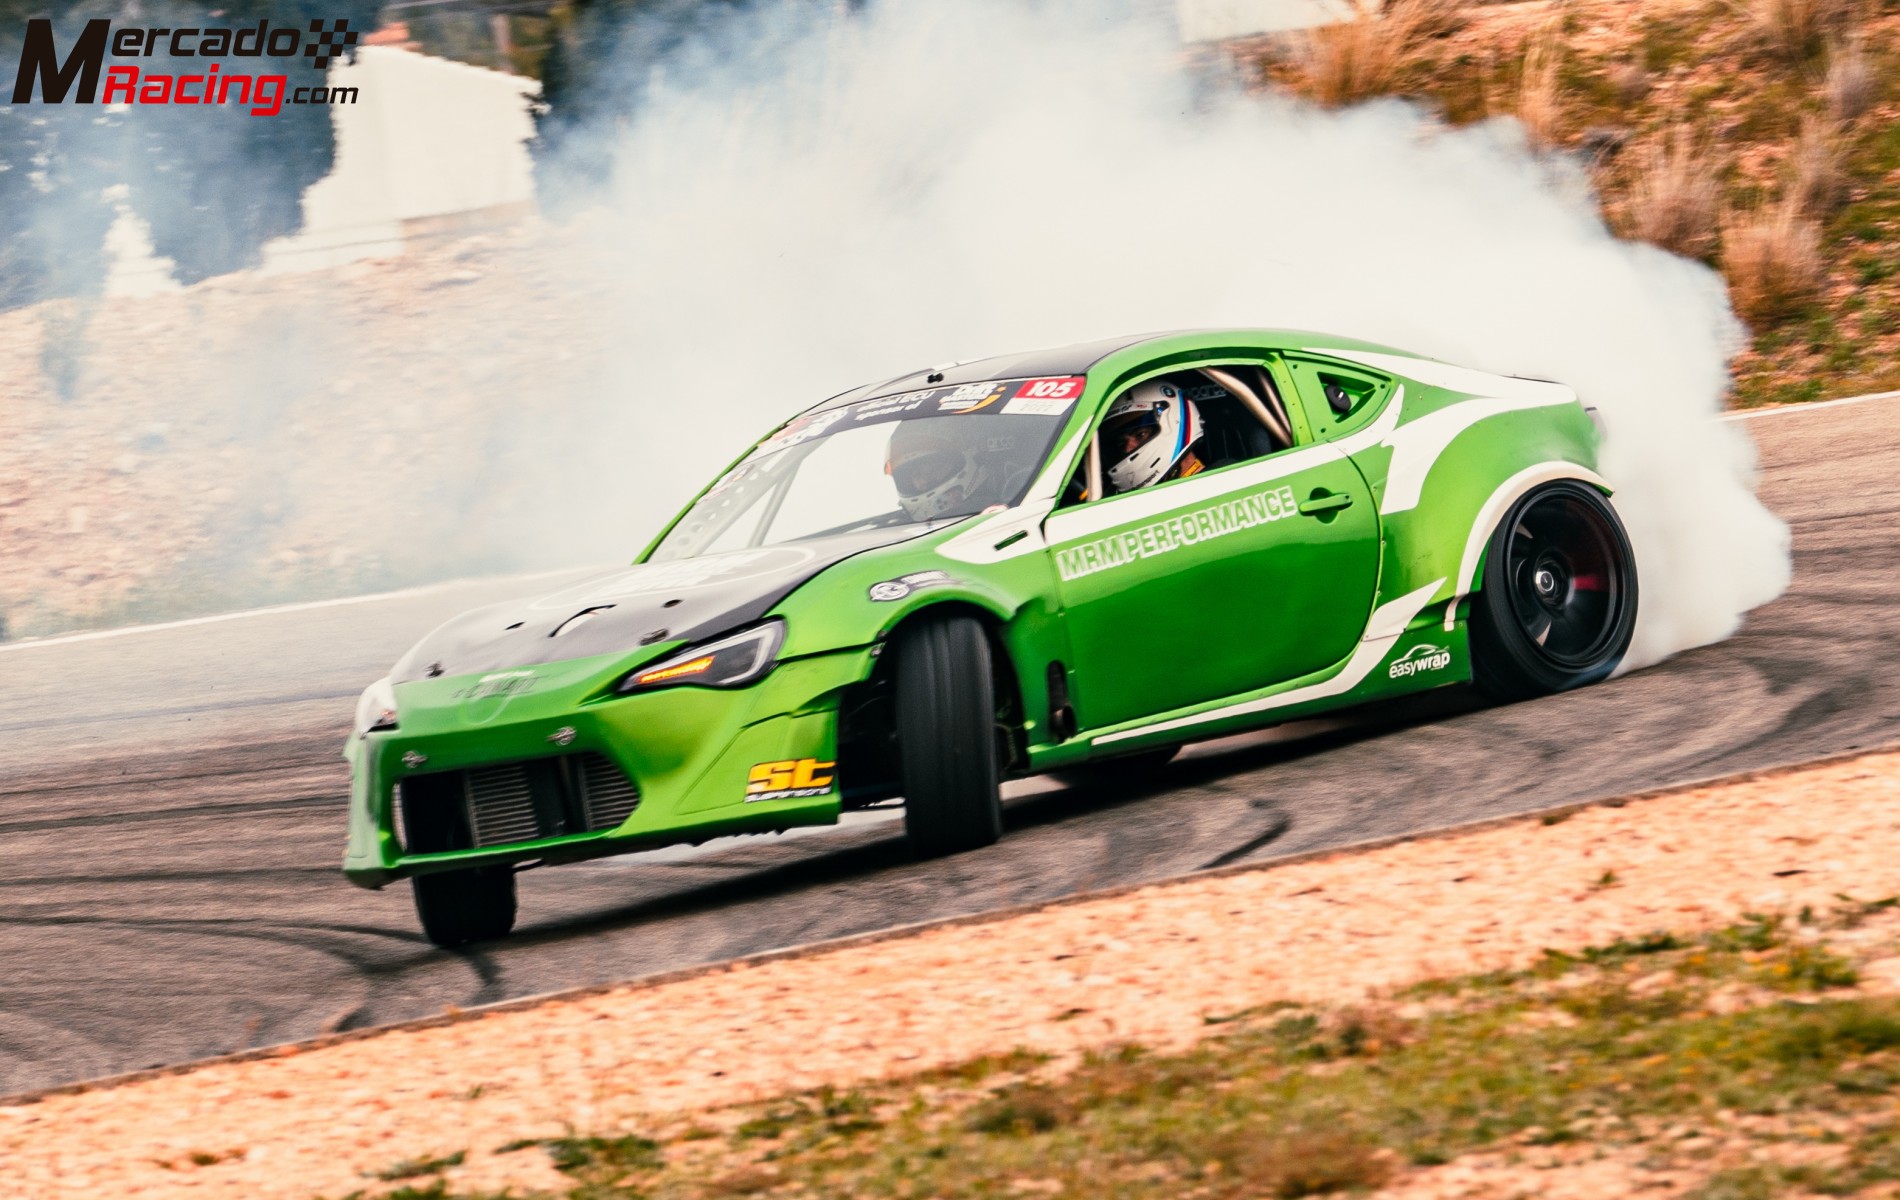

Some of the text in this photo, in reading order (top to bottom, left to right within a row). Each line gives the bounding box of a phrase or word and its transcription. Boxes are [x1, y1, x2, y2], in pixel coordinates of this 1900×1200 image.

[1026, 381, 1077, 398] 105
[1122, 485, 1299, 562] PERFORMANCE
[1389, 652, 1451, 679] easywrap
